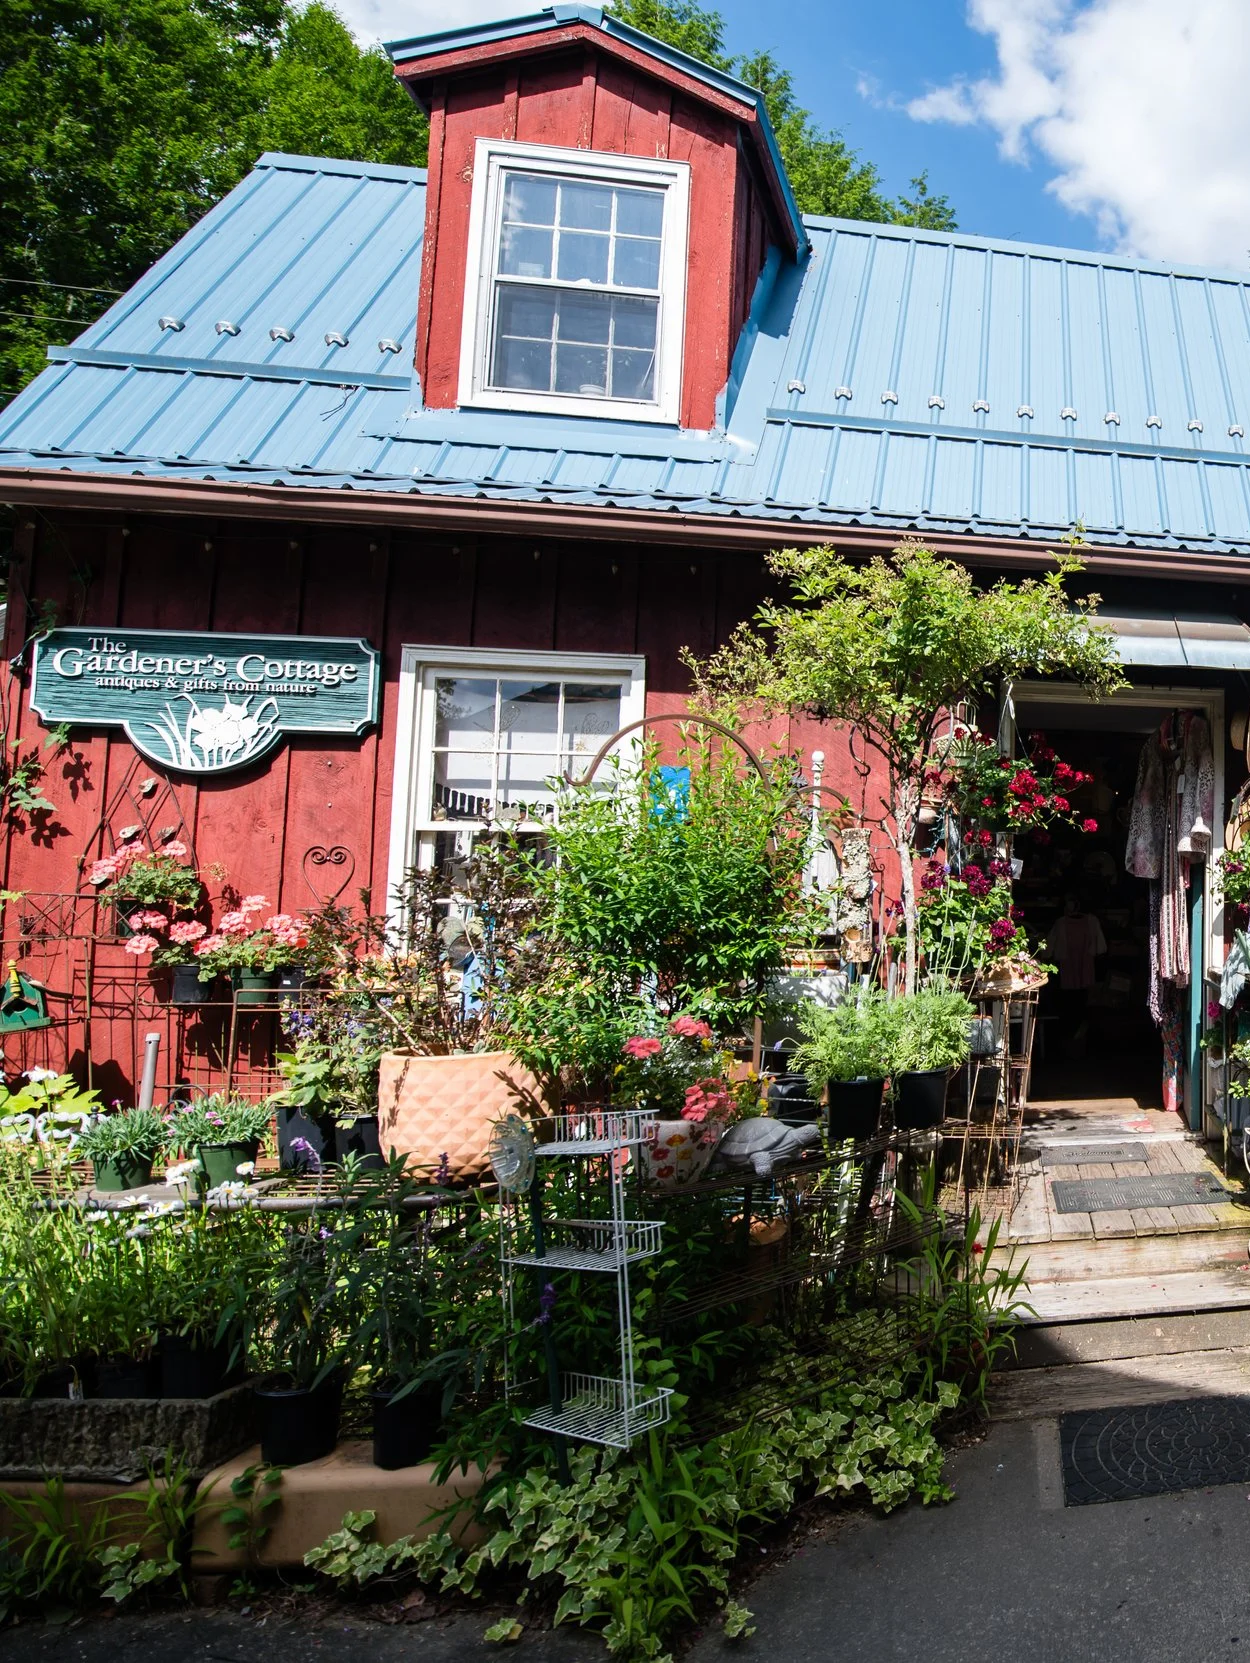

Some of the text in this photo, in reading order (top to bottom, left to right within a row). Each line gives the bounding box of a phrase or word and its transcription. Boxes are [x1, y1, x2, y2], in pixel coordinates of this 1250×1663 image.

[88, 637, 127, 653] The
[52, 647, 358, 685] Gardener's Cottage
[95, 676, 316, 693] antiques & gifts from nature
